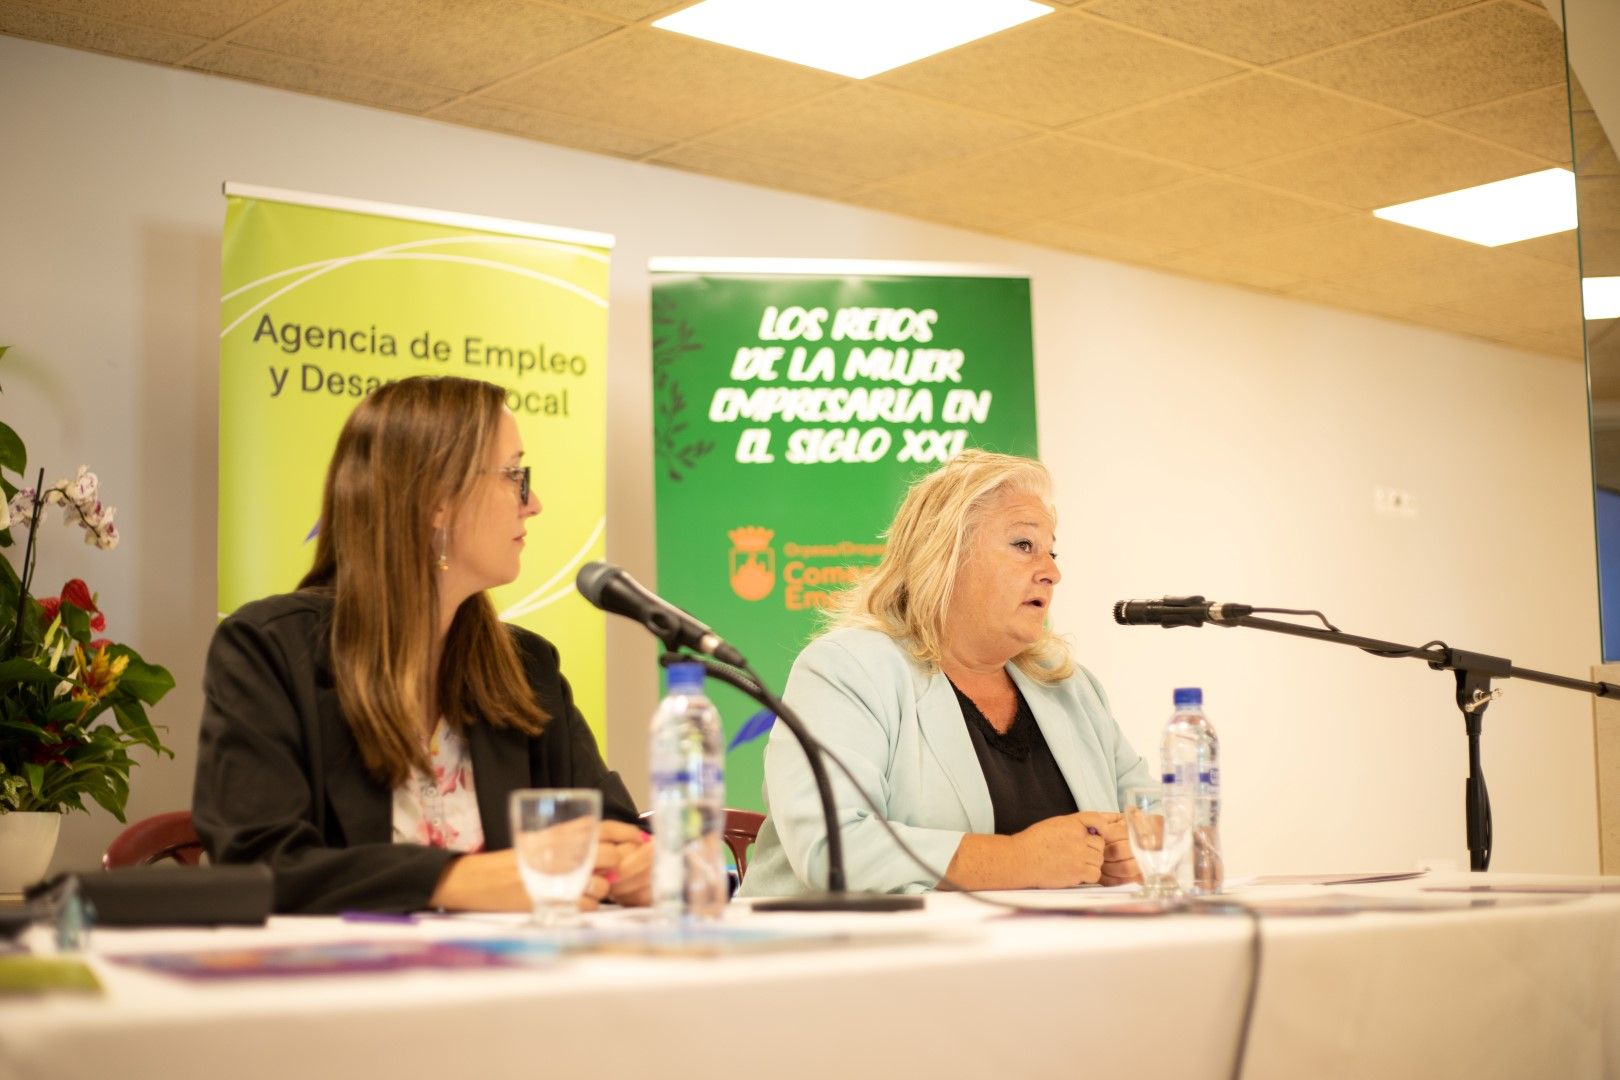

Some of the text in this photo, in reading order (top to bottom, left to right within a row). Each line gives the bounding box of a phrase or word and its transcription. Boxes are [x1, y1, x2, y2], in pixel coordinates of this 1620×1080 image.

[757, 305, 938, 343] LOS RETOS
[252, 313, 587, 377] Agencia de Empleo
[729, 346, 966, 385] DE LA MUJER
[269, 365, 289, 397] y
[503, 388, 570, 417] ocal
[708, 387, 992, 424] EMPRESARIA EN
[735, 426, 969, 464] EL SIGLO XXI
